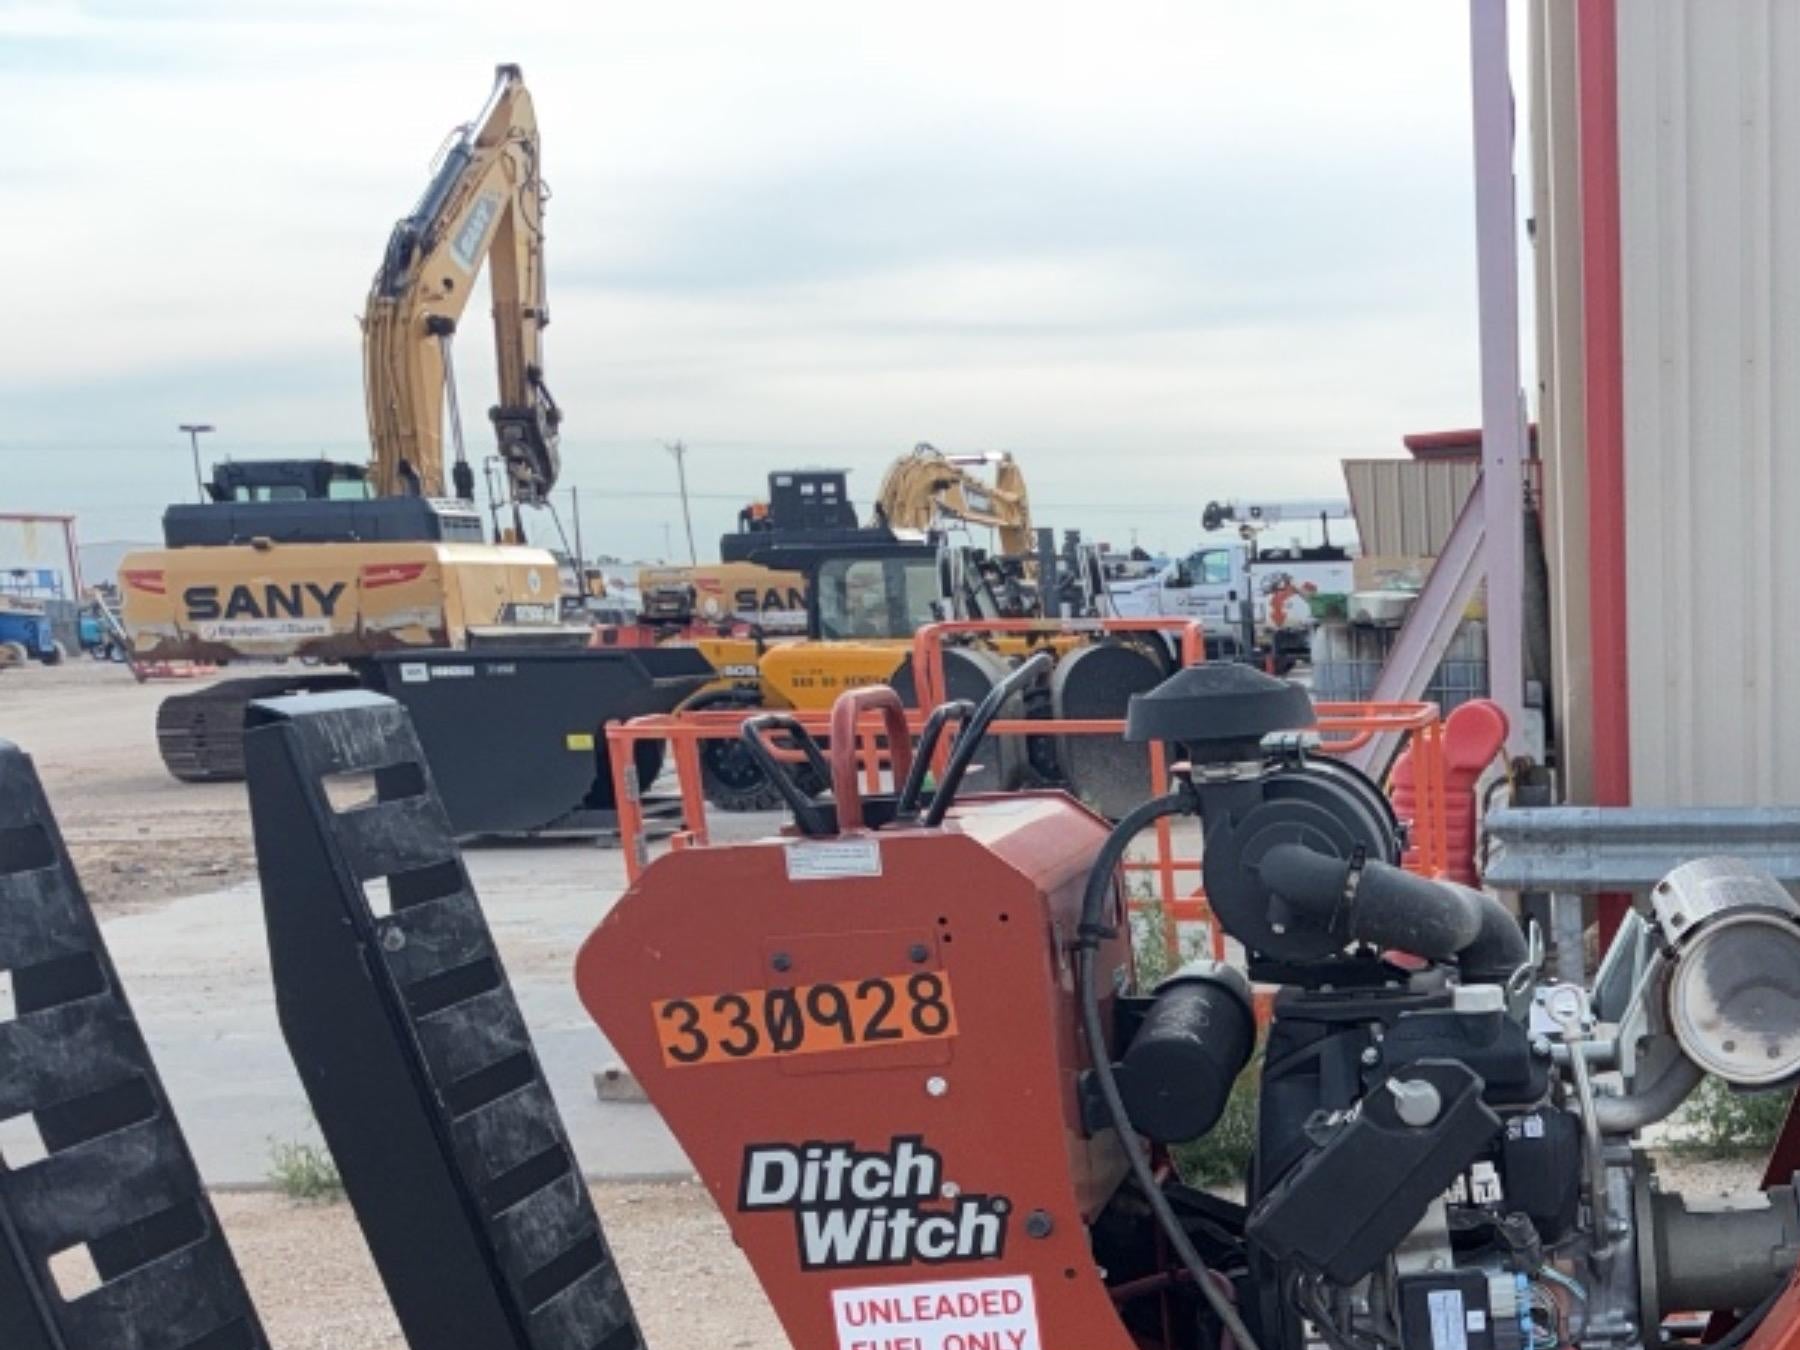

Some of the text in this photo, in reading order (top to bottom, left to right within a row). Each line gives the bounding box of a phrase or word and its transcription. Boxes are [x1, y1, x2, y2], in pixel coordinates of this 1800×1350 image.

[183, 581, 346, 621] SANY
[661, 972, 950, 1063] 330928
[746, 1142, 935, 1206] Ditch
[844, 1289, 1024, 1327] UNLEADED
